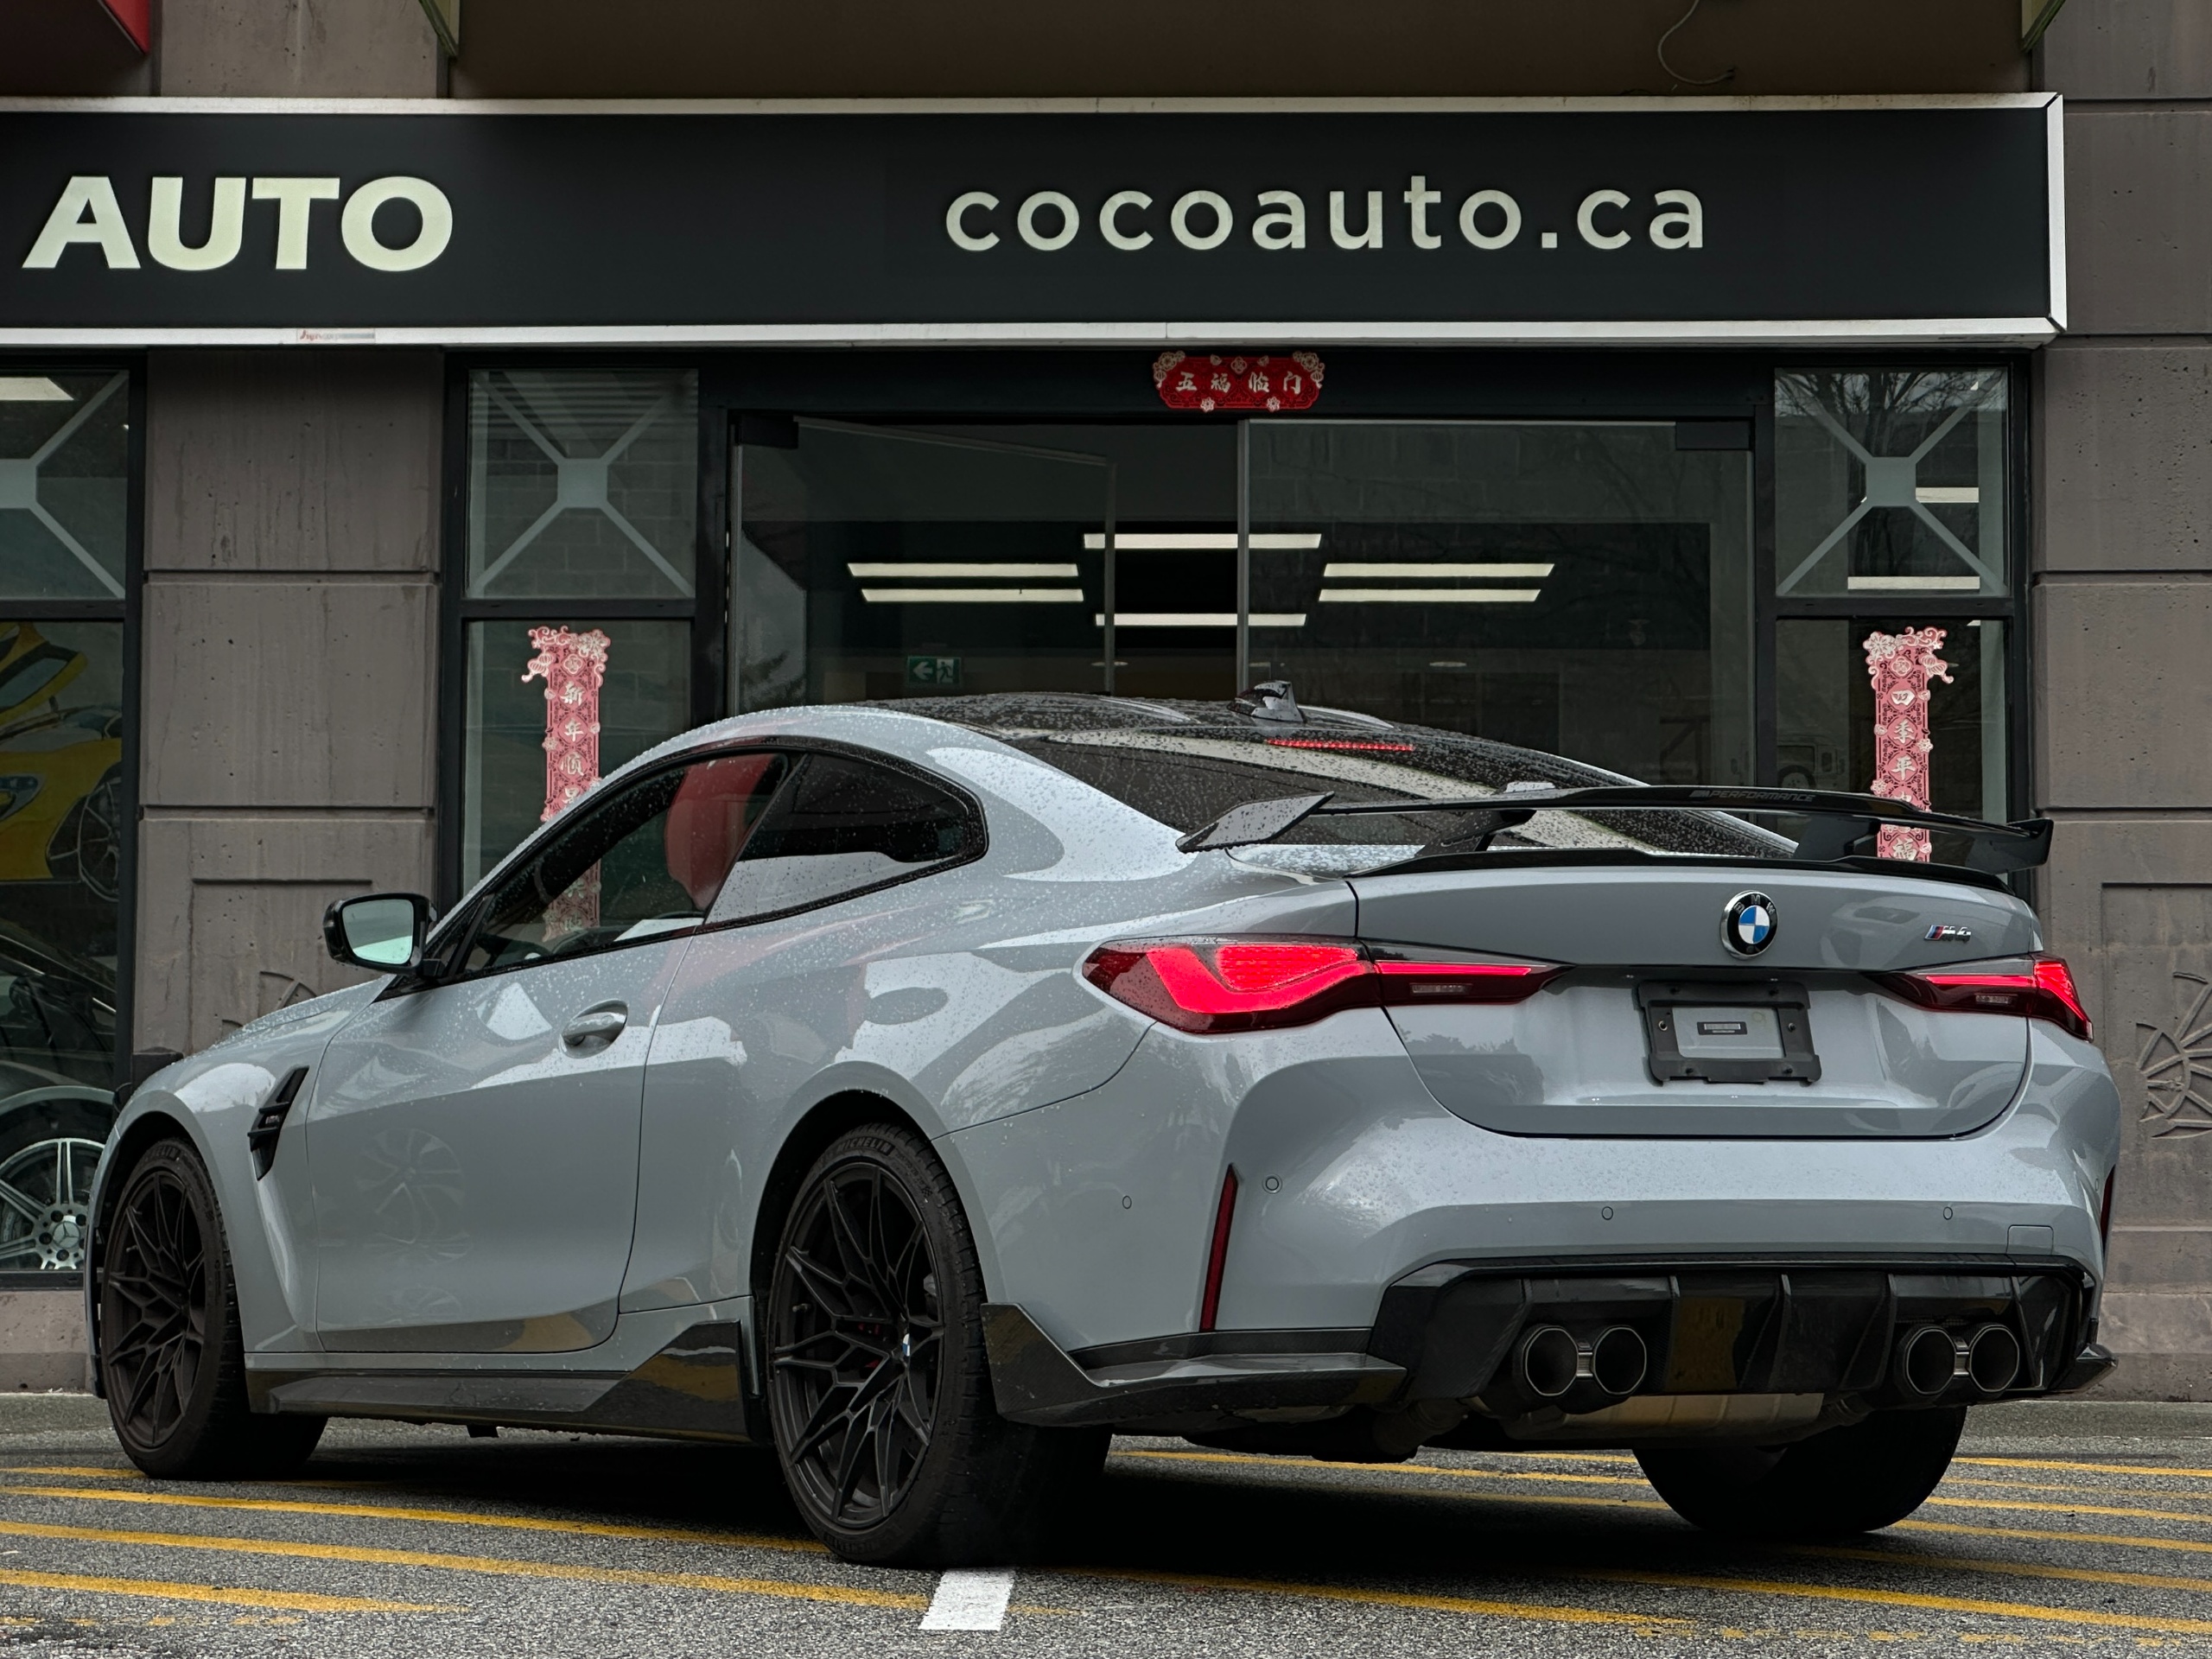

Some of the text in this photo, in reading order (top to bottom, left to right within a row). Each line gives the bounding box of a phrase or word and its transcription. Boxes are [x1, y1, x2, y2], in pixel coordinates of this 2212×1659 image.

[22, 175, 453, 271] AUTO
[946, 176, 1703, 251] cocoauto.ca
[1175, 372, 1301, 395] 五福临门
[1709, 790, 1815, 802] PERFORMANCE
[1733, 894, 1776, 914] BMW
[836, 1137, 891, 1153] MICHELIN
